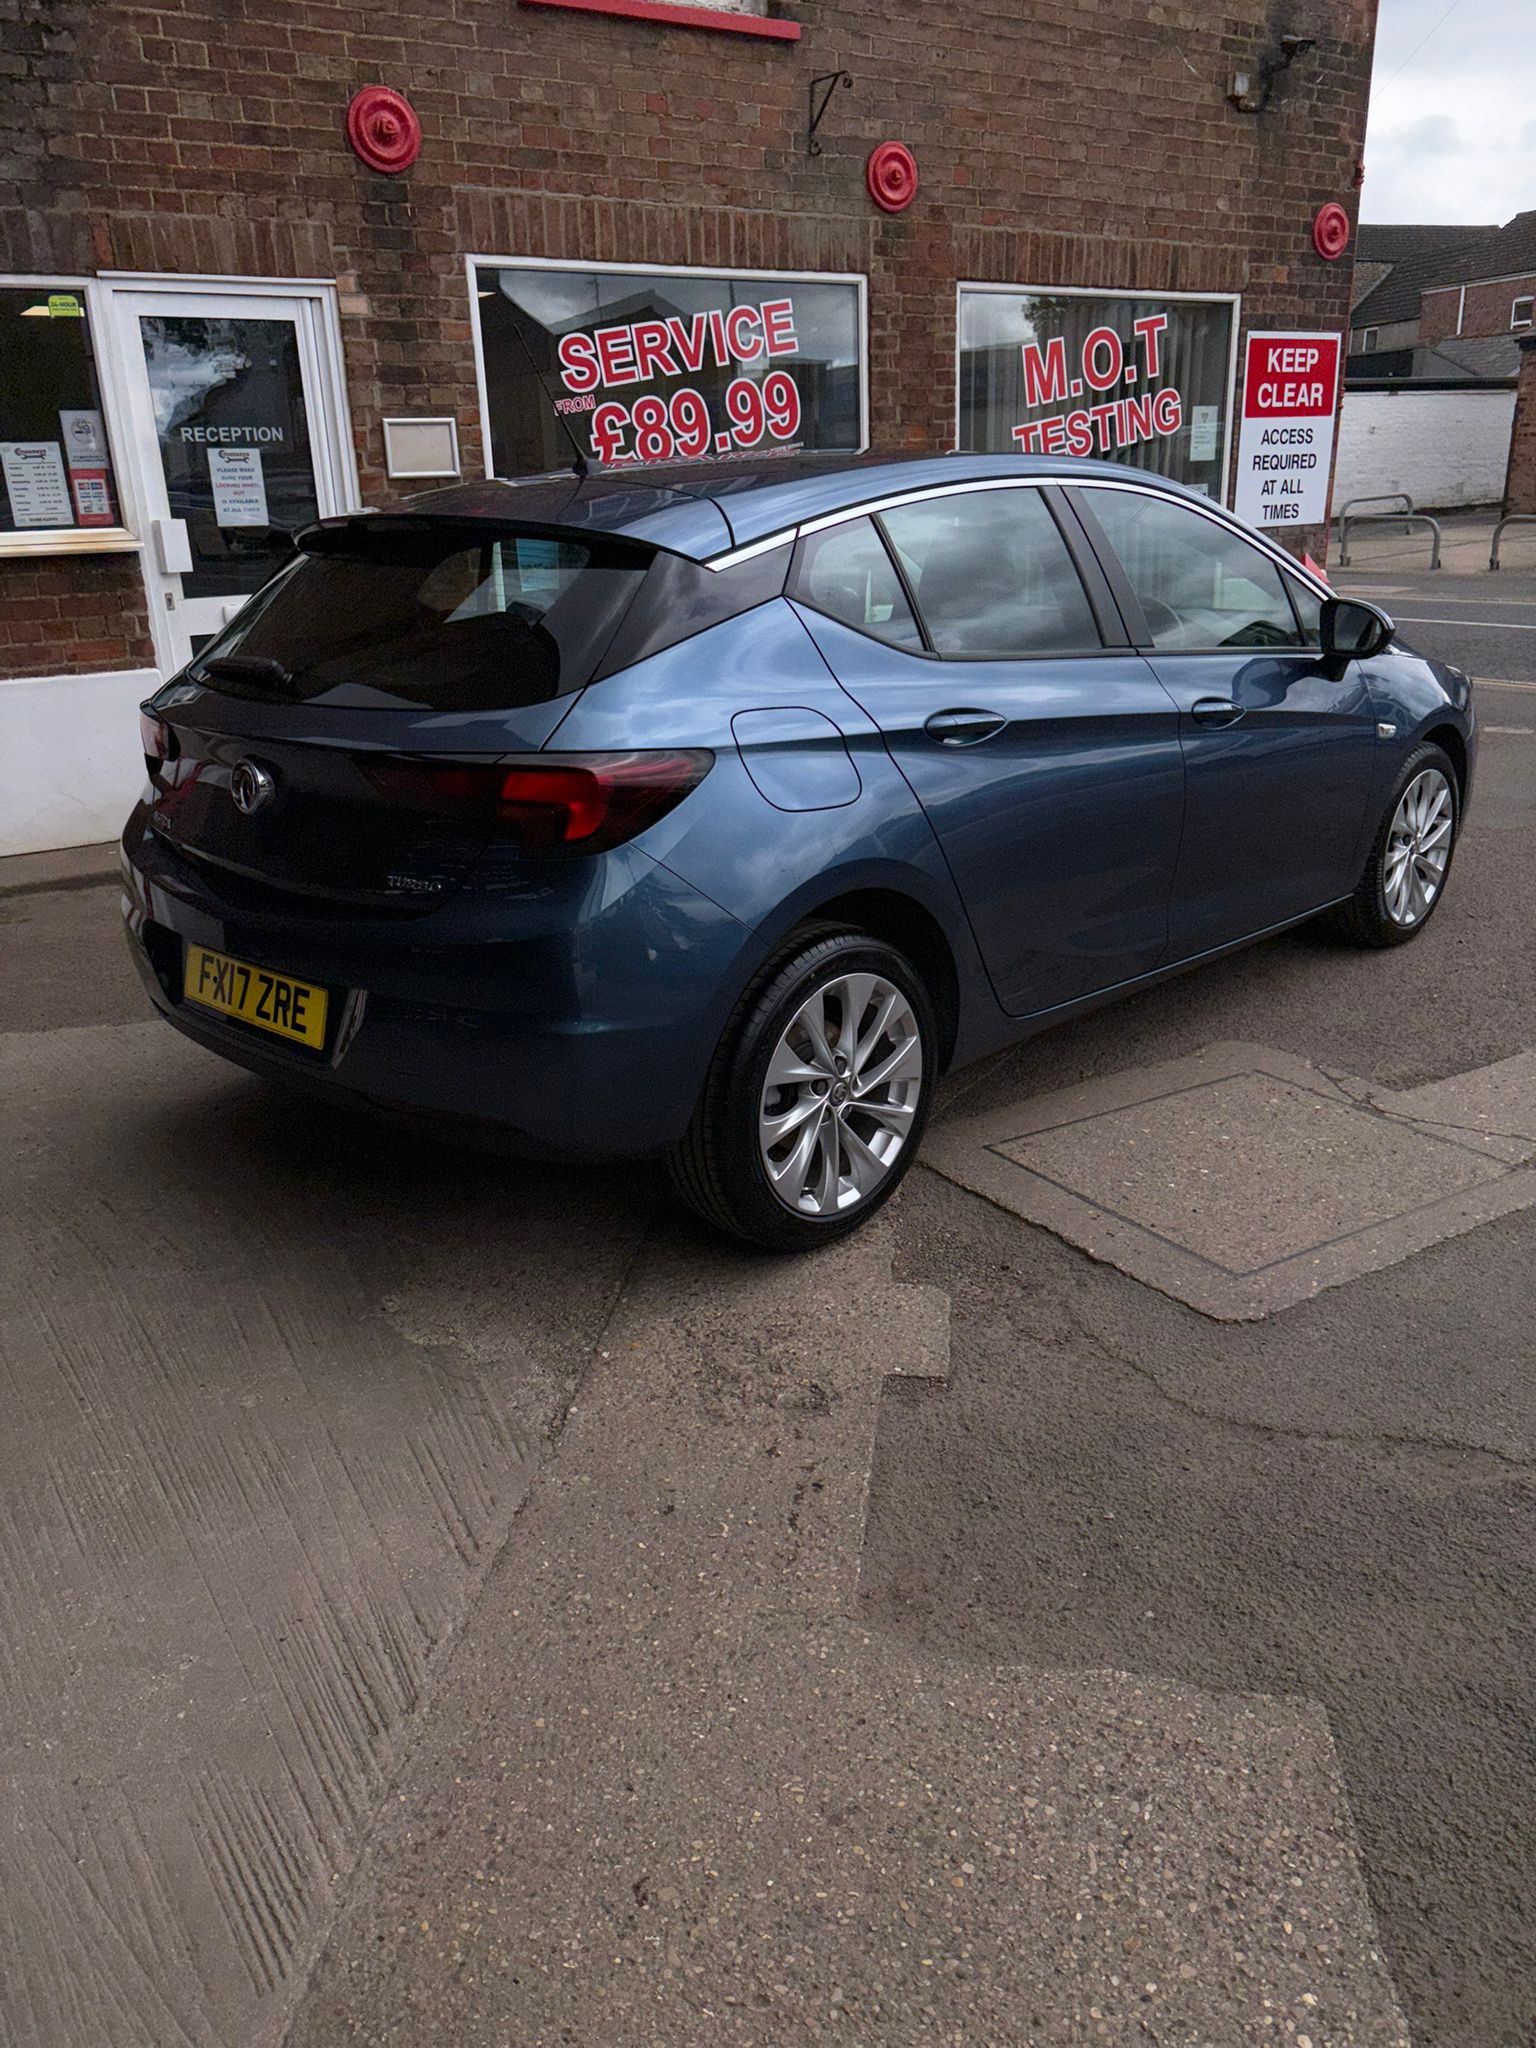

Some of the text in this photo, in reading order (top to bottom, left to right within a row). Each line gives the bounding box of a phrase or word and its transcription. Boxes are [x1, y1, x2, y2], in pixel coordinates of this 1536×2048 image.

[558, 298, 799, 393] SERVICE
[1021, 312, 1168, 408] M.O.T
[1267, 347, 1319, 374] KEEP
[554, 394, 596, 416] FROM
[1257, 382, 1324, 408] CLEAR
[590, 370, 801, 464] £89.99
[1011, 387, 1182, 457] TESTING
[181, 427, 284, 442] RECEPTION
[1260, 427, 1314, 446] ACCESS
[1252, 453, 1317, 472] REQUIRED
[1260, 478, 1304, 497] AT ALL
[1262, 503, 1300, 522] TIMES
[198, 952, 310, 1034] FX17 ZRE
